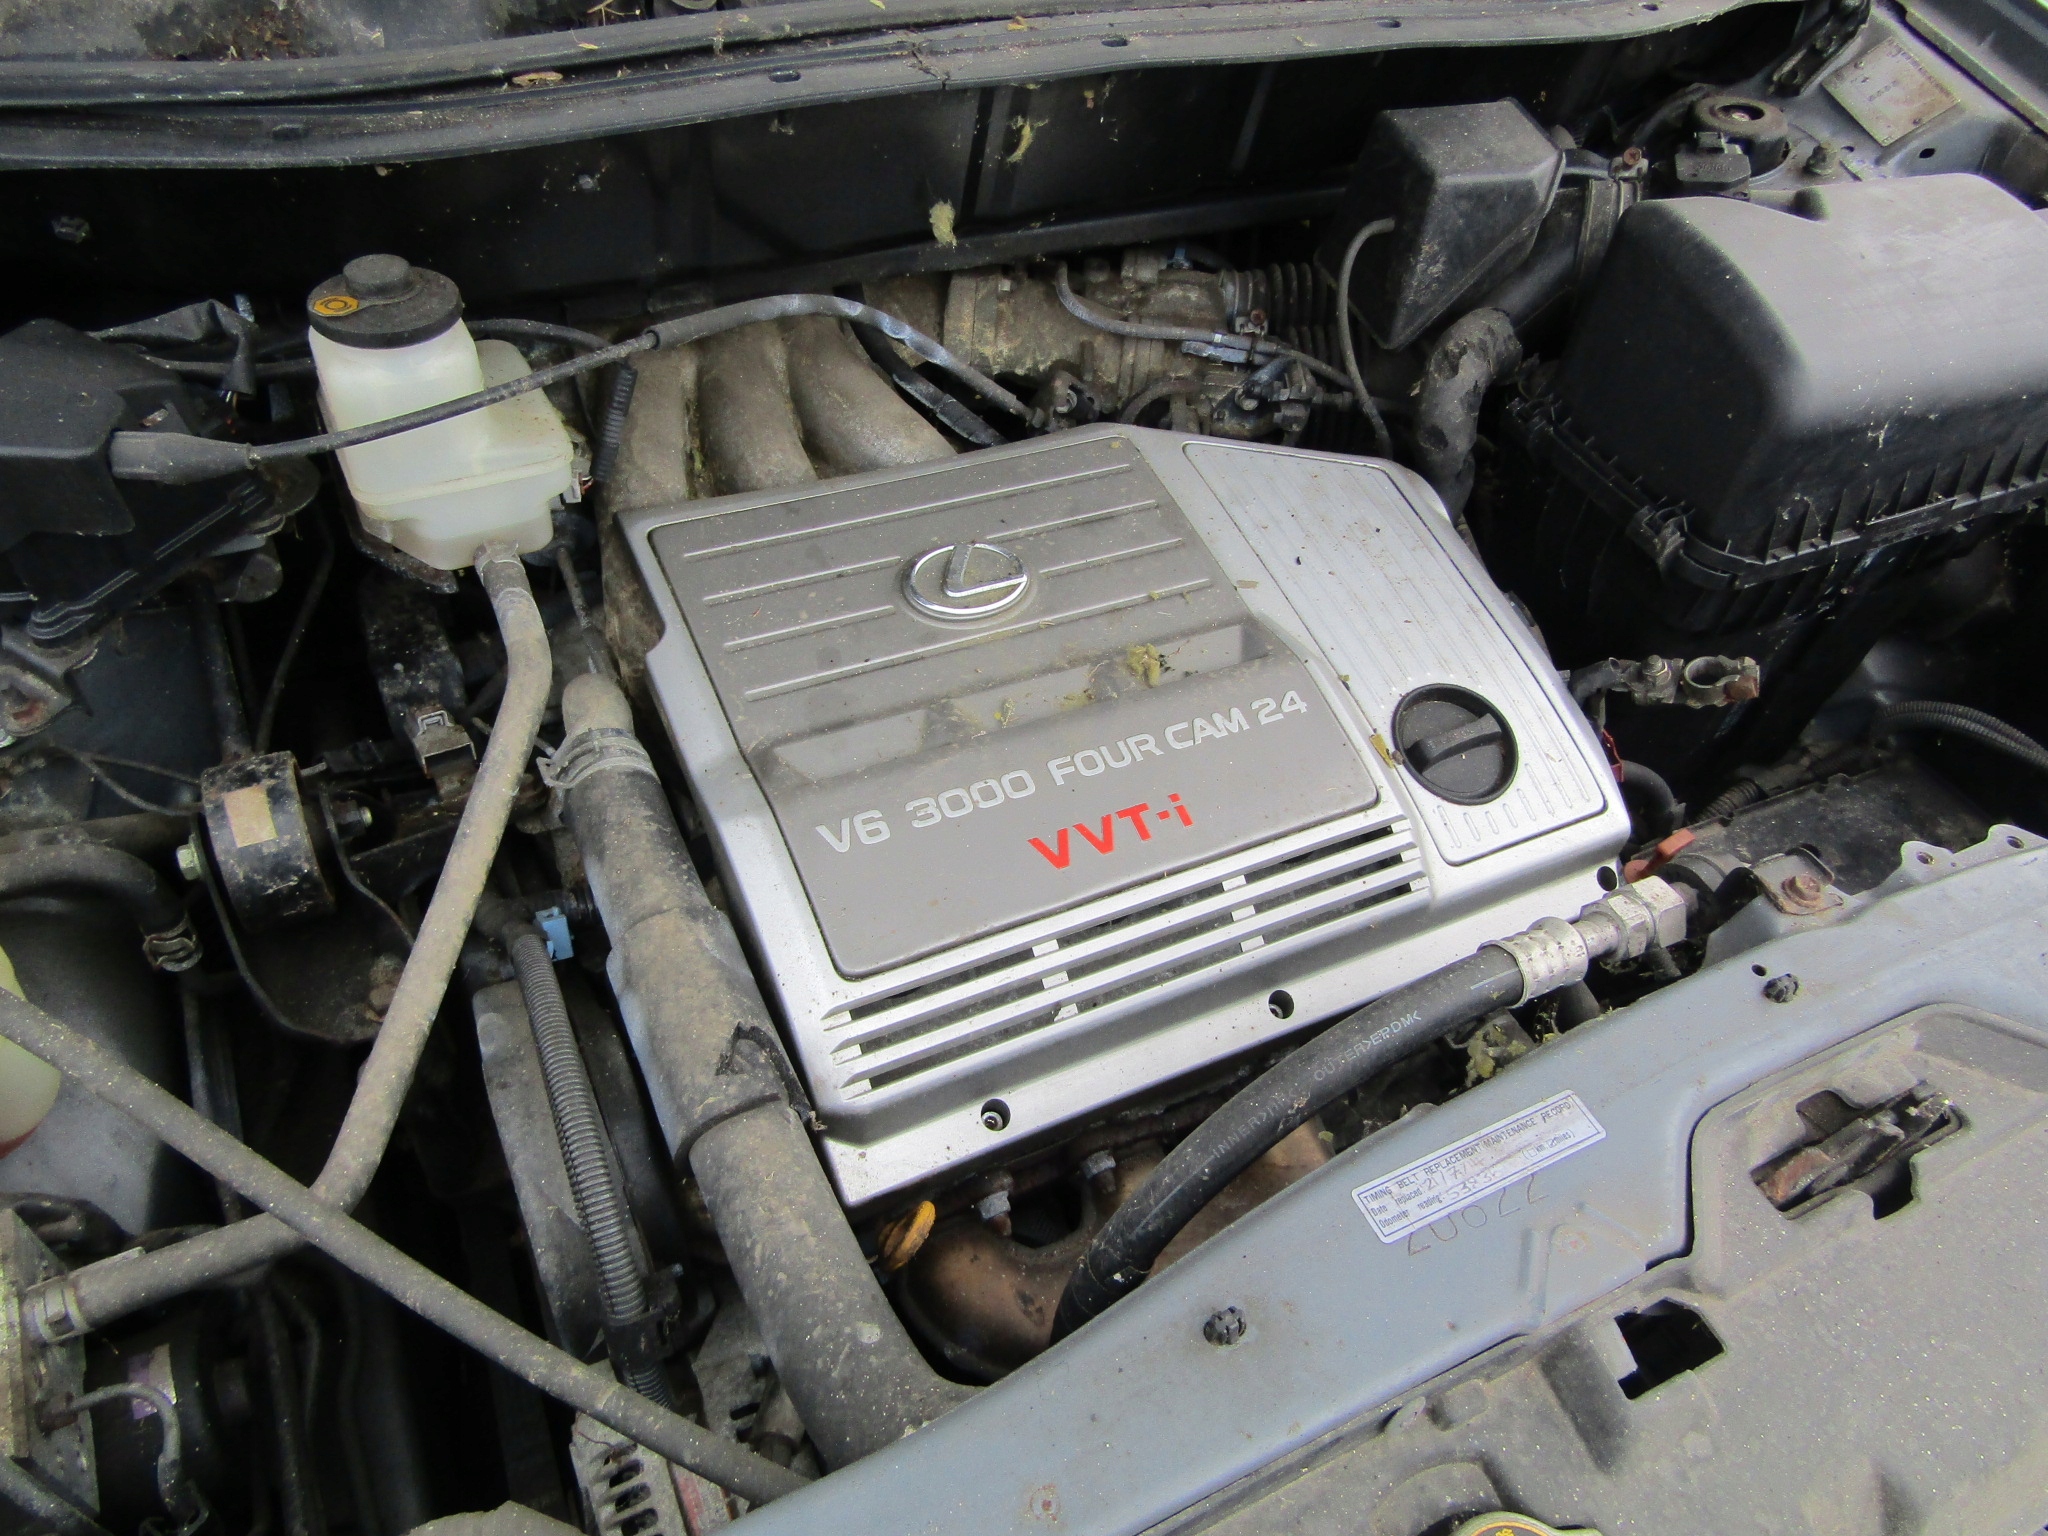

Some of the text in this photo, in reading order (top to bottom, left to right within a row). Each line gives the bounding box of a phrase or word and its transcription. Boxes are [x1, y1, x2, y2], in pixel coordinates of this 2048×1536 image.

[816, 690, 1308, 853] V6 3000 FOUR CAM 24
[1363, 1186, 1393, 1204] TIMING
[1396, 1173, 1420, 1189] BELT
[1370, 1204, 1388, 1216] Date
[1378, 1209, 1409, 1228] Odometer
